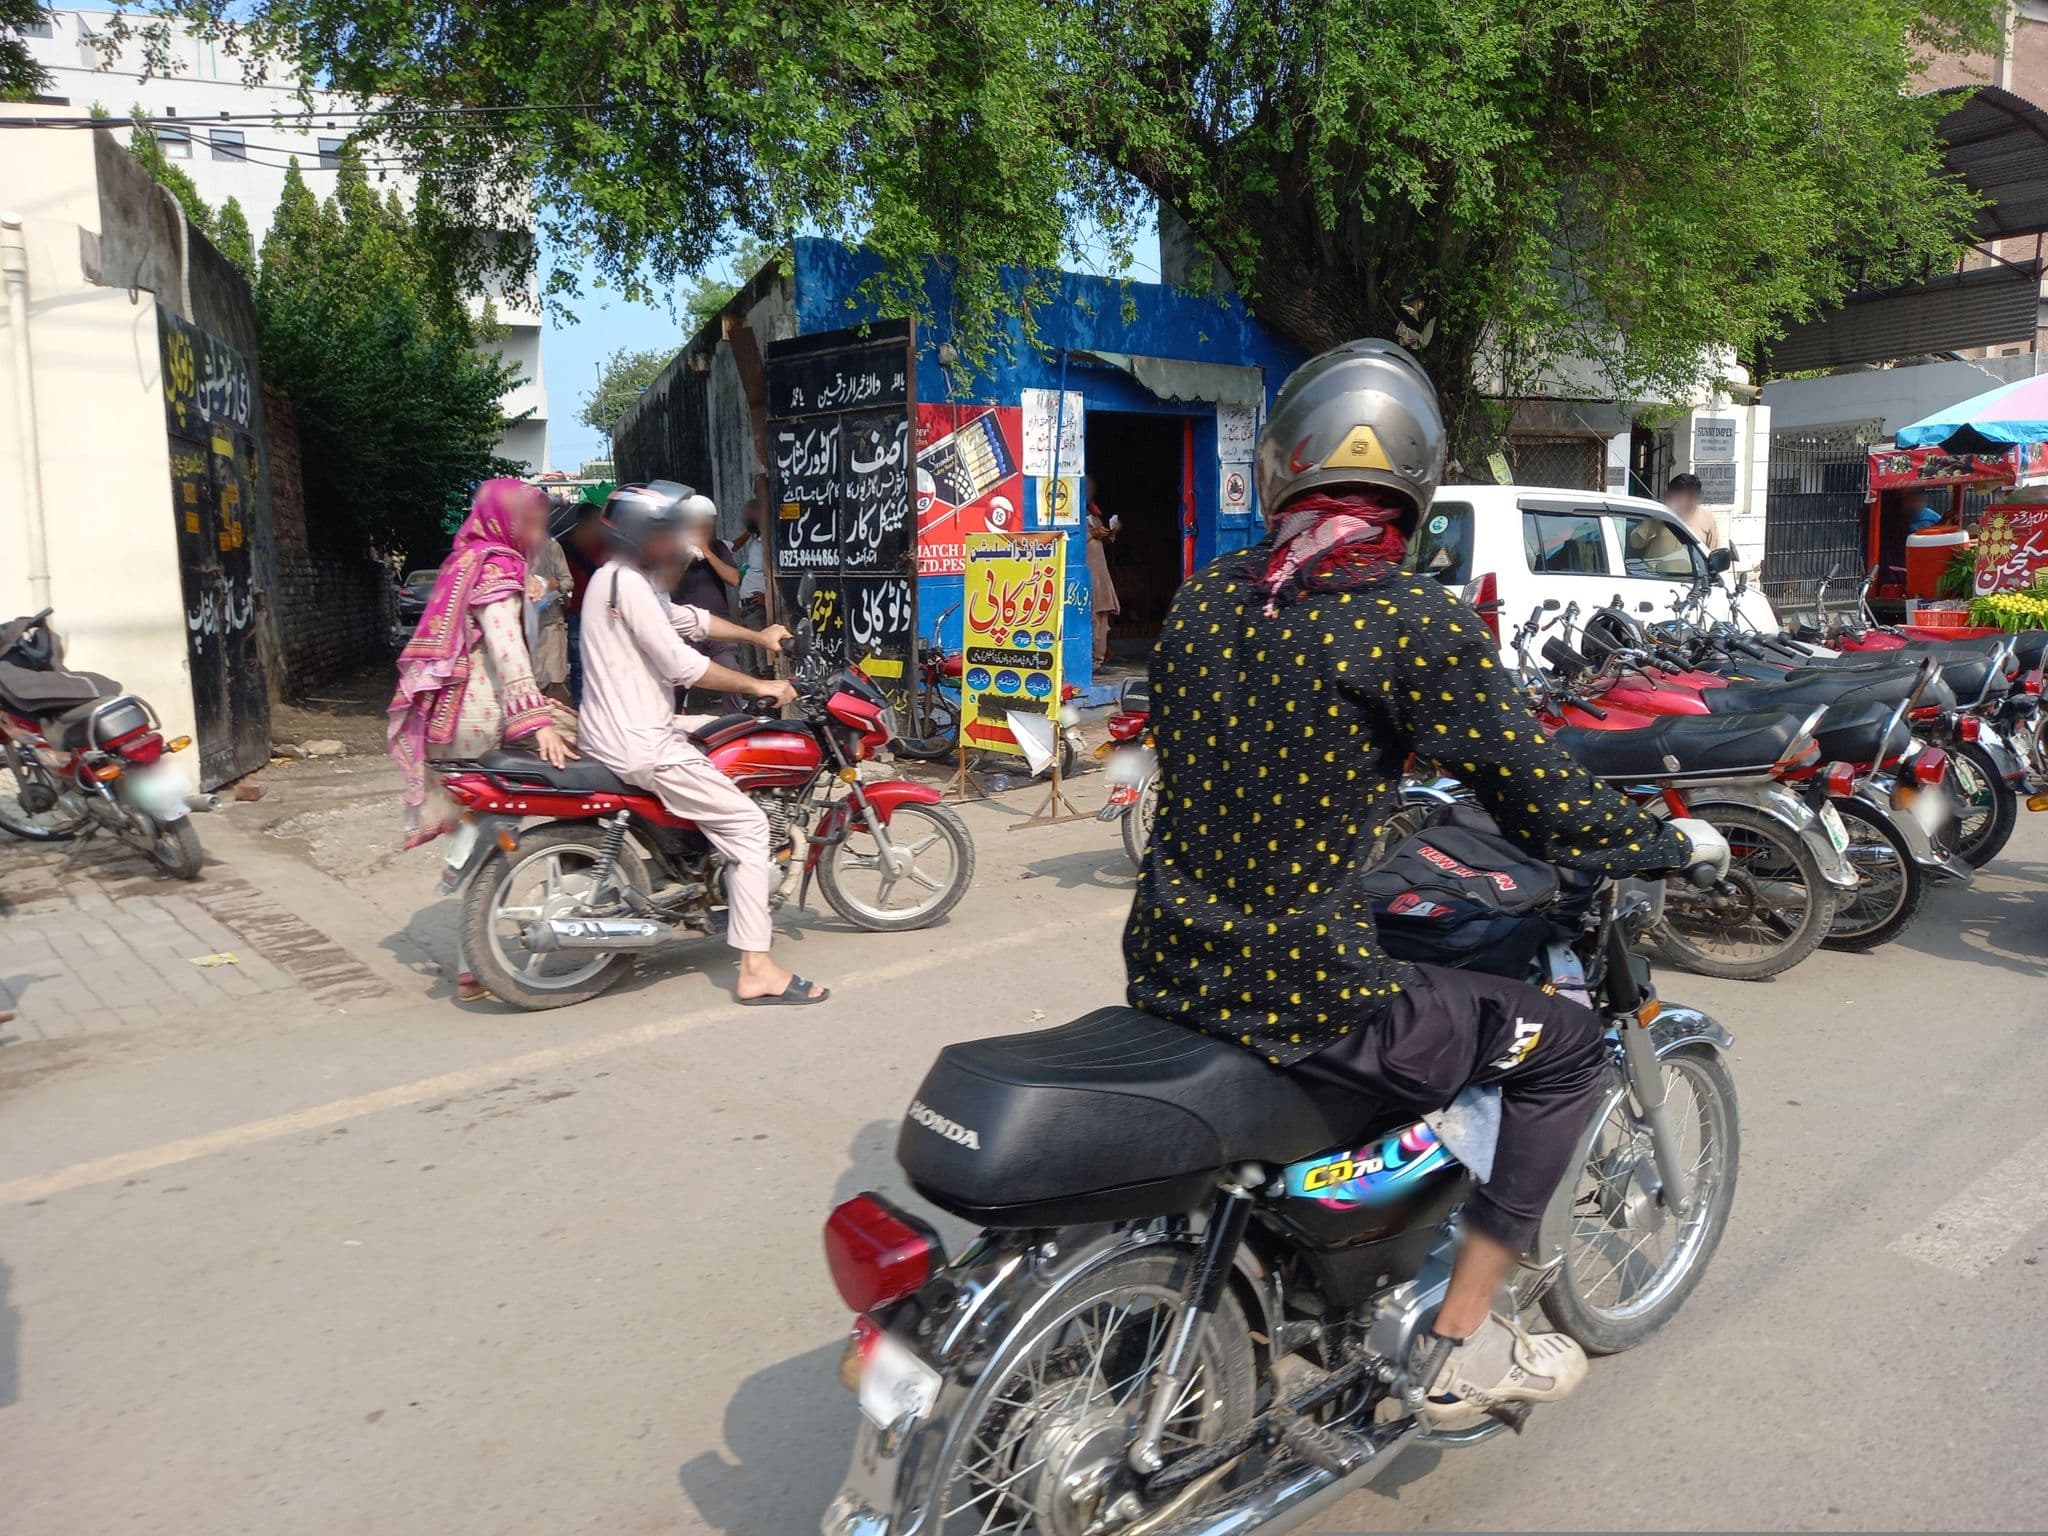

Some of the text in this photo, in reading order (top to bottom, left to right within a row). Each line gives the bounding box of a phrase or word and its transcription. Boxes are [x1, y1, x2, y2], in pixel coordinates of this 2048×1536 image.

[851, 420, 909, 474] آصف
[809, 508, 836, 543] اے
[994, 510, 1004, 523] 15
[908, 1100, 981, 1151] HONDA
